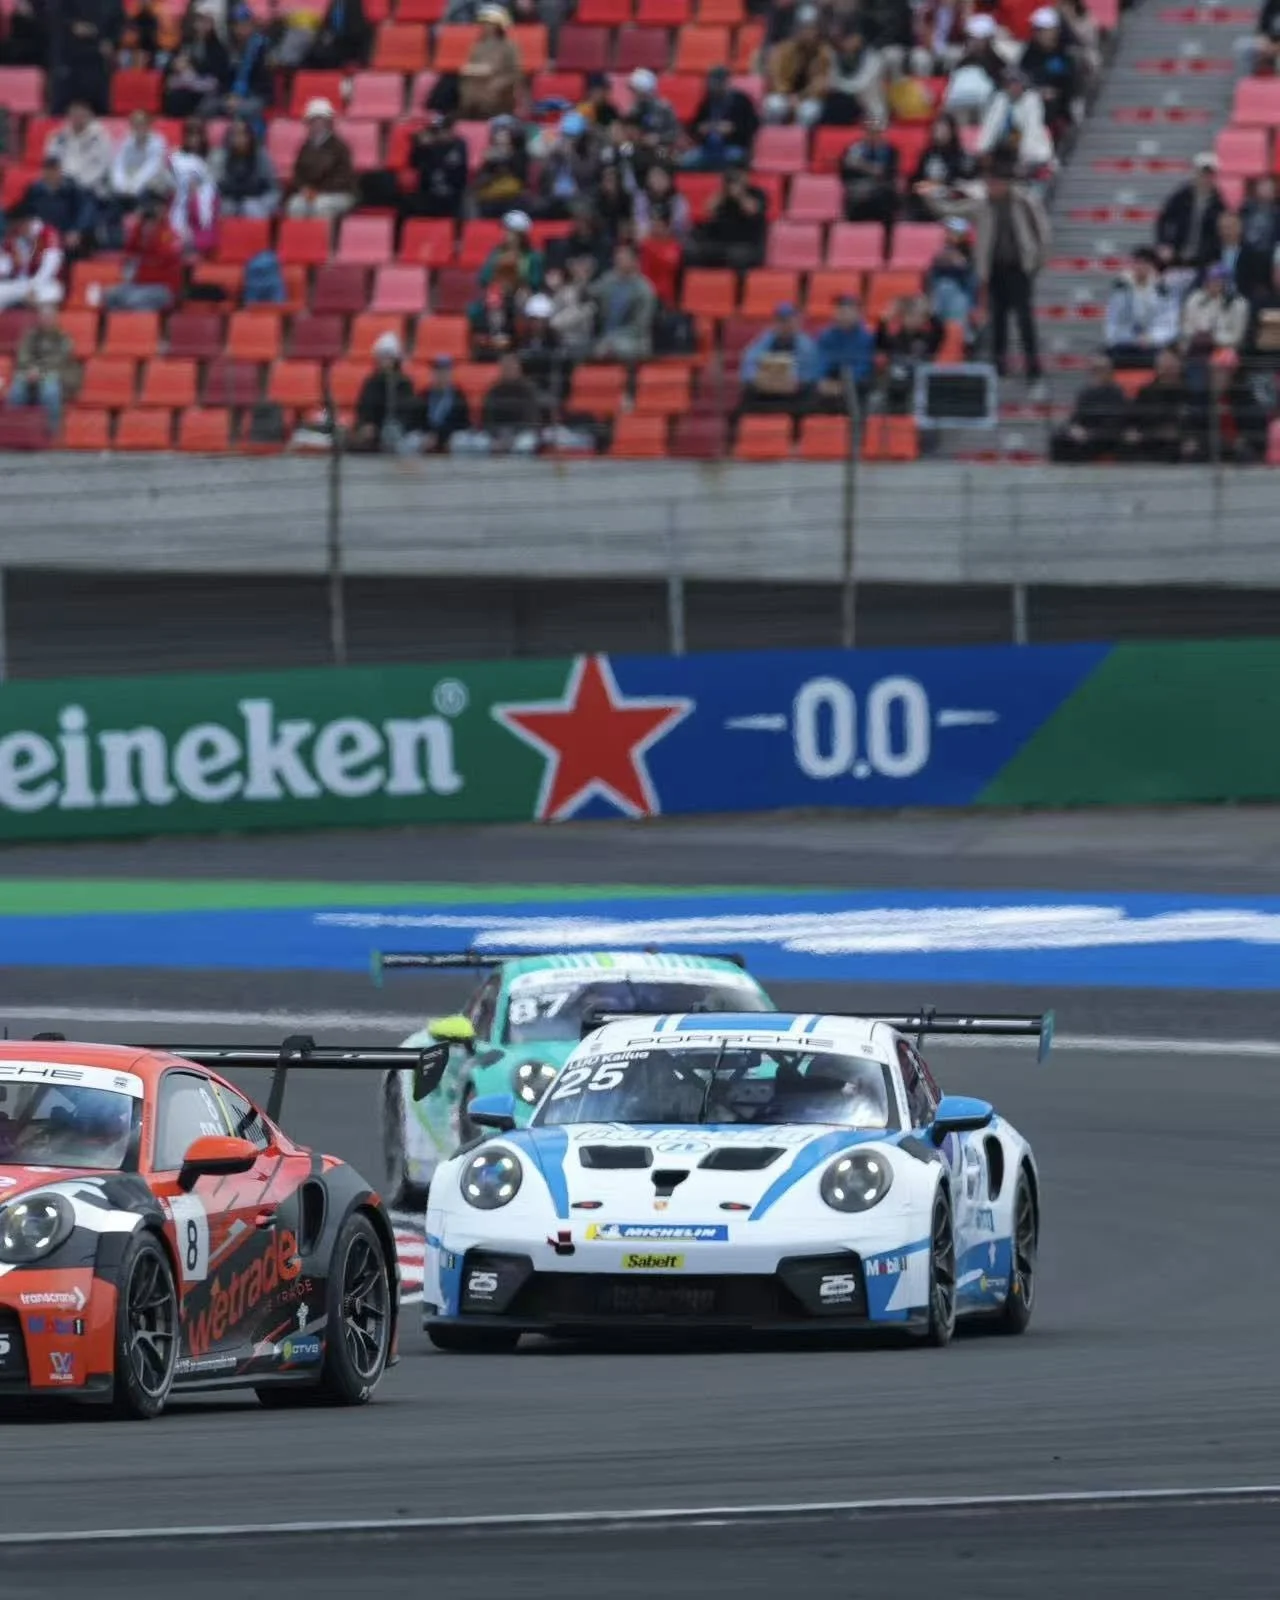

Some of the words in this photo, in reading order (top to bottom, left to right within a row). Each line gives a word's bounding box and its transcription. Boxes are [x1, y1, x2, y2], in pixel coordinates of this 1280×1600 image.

[793, 675, 930, 779] 0.0
[509, 991, 571, 1025] 87
[627, 1034, 834, 1048] PORSCHE
[550, 1061, 631, 1101] 25
[187, 1219, 198, 1271] 8
[623, 1227, 717, 1238] MICHELIN
[627, 1254, 680, 1269] Sabelt
[865, 1256, 901, 1276] Mobil
[180, 1229, 303, 1361] wetrade
